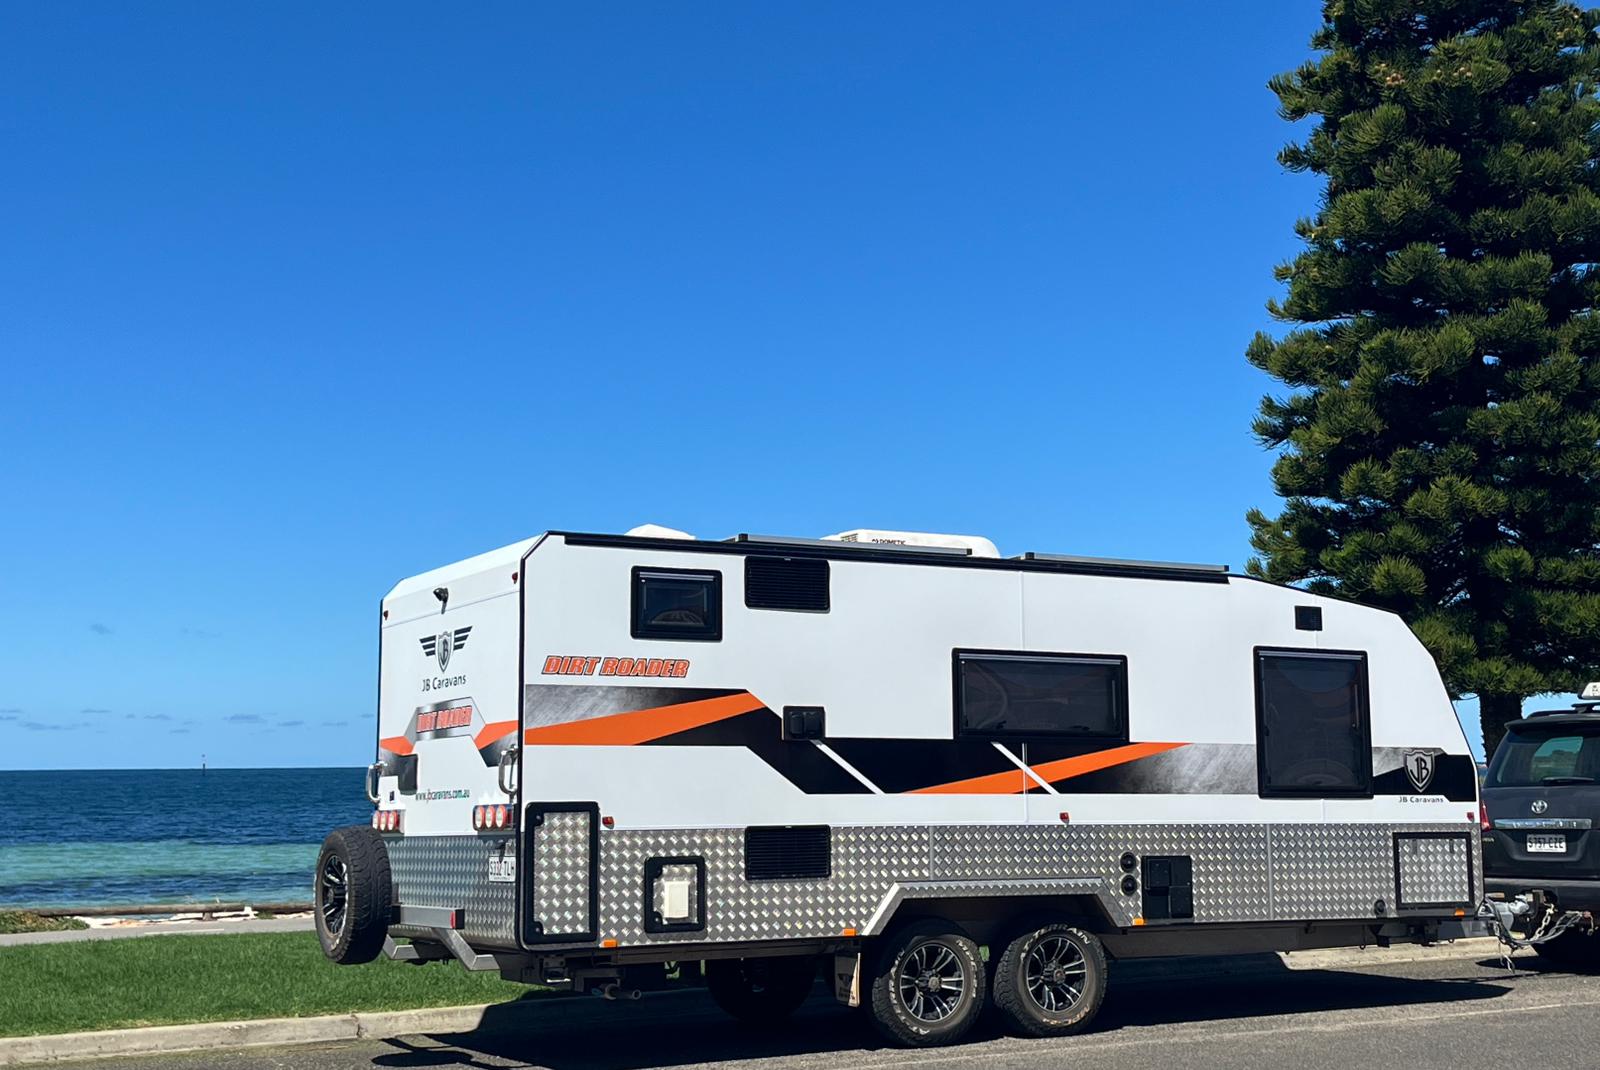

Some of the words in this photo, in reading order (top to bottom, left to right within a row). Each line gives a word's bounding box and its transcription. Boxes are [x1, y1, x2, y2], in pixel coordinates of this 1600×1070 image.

[542, 655, 601, 676] DIRT
[599, 656, 690, 678] ROADER
[421, 679, 431, 692] JB
[432, 674, 467, 690] Caravans
